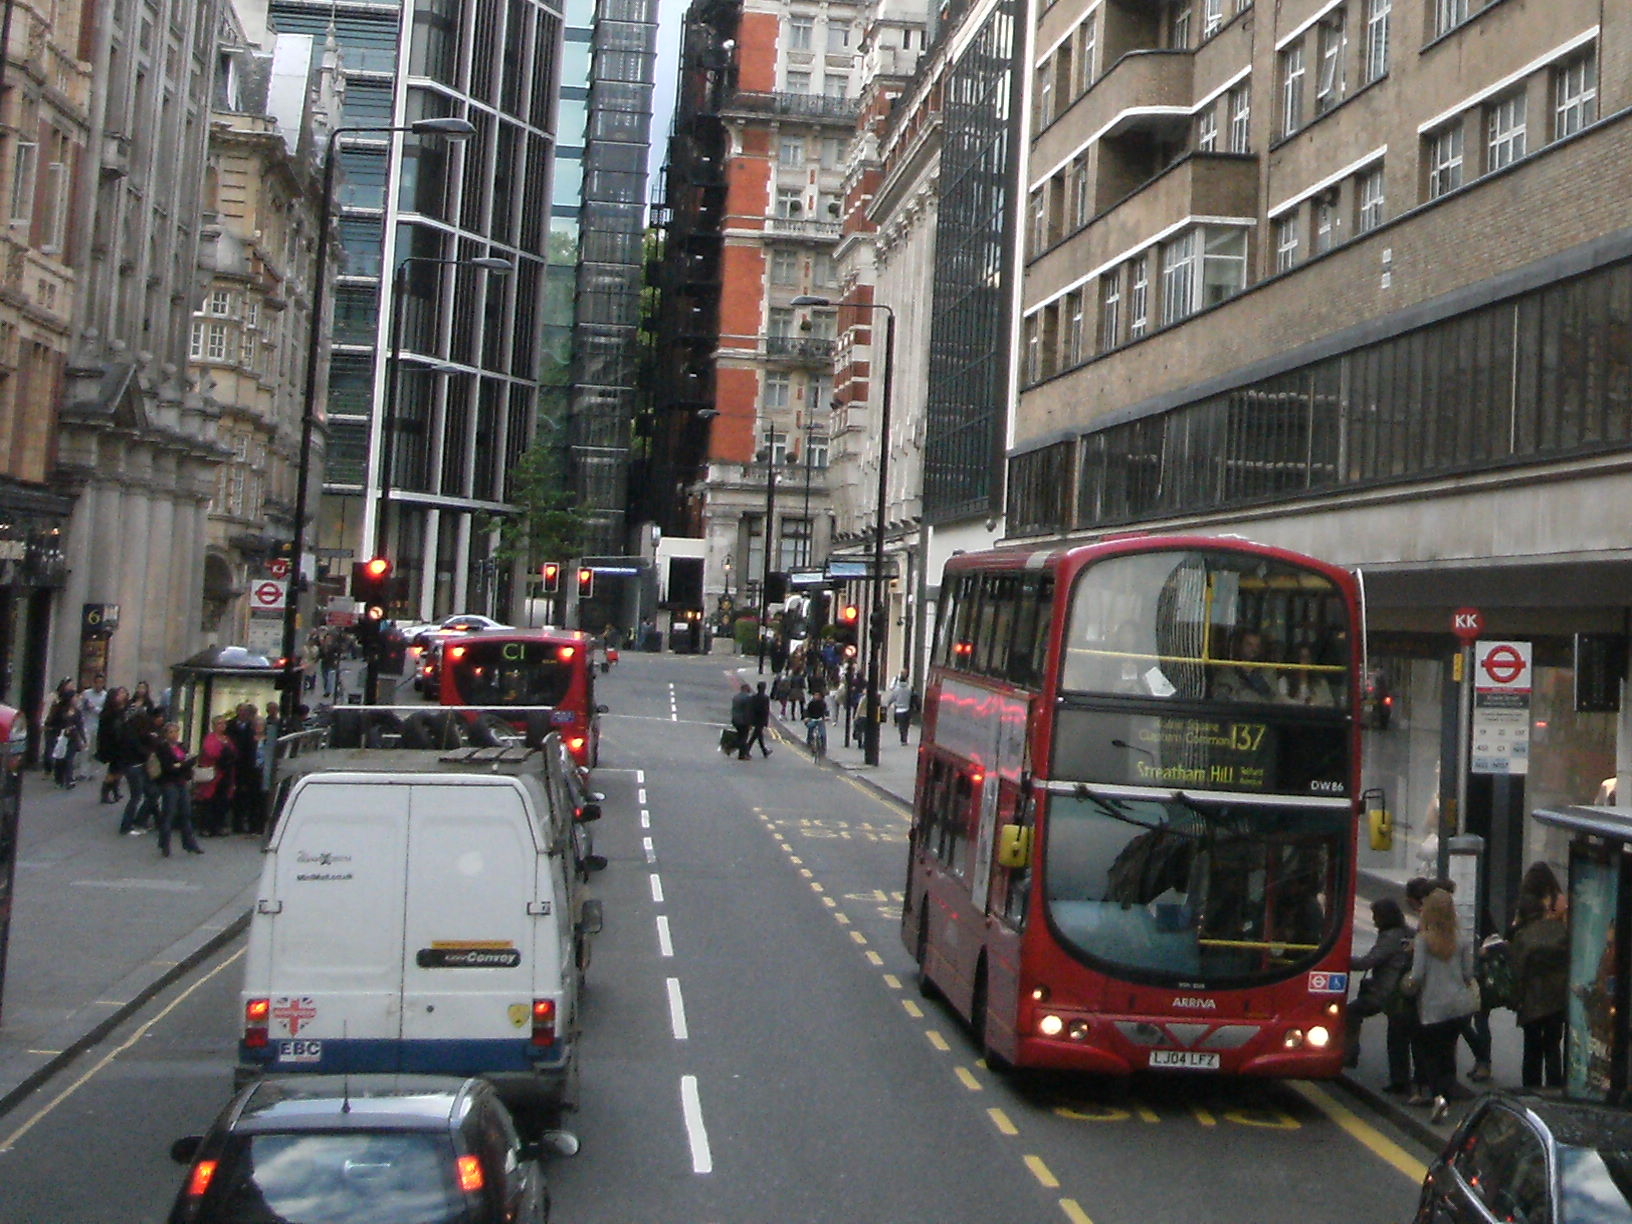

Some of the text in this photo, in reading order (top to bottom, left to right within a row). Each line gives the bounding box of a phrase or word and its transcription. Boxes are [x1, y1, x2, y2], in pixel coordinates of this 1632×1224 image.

[88, 609, 100, 625] 6
[1455, 614, 1478, 628] KK
[1231, 723, 1266, 752] 137
[1136, 759, 1234, 784] Streatham Hill
[465, 951, 517, 964] Convoy
[1172, 996, 1217, 1010] ARRIVA
[281, 1042, 320, 1056] EBC
[1153, 1052, 1216, 1066] LJ04 LFZ
